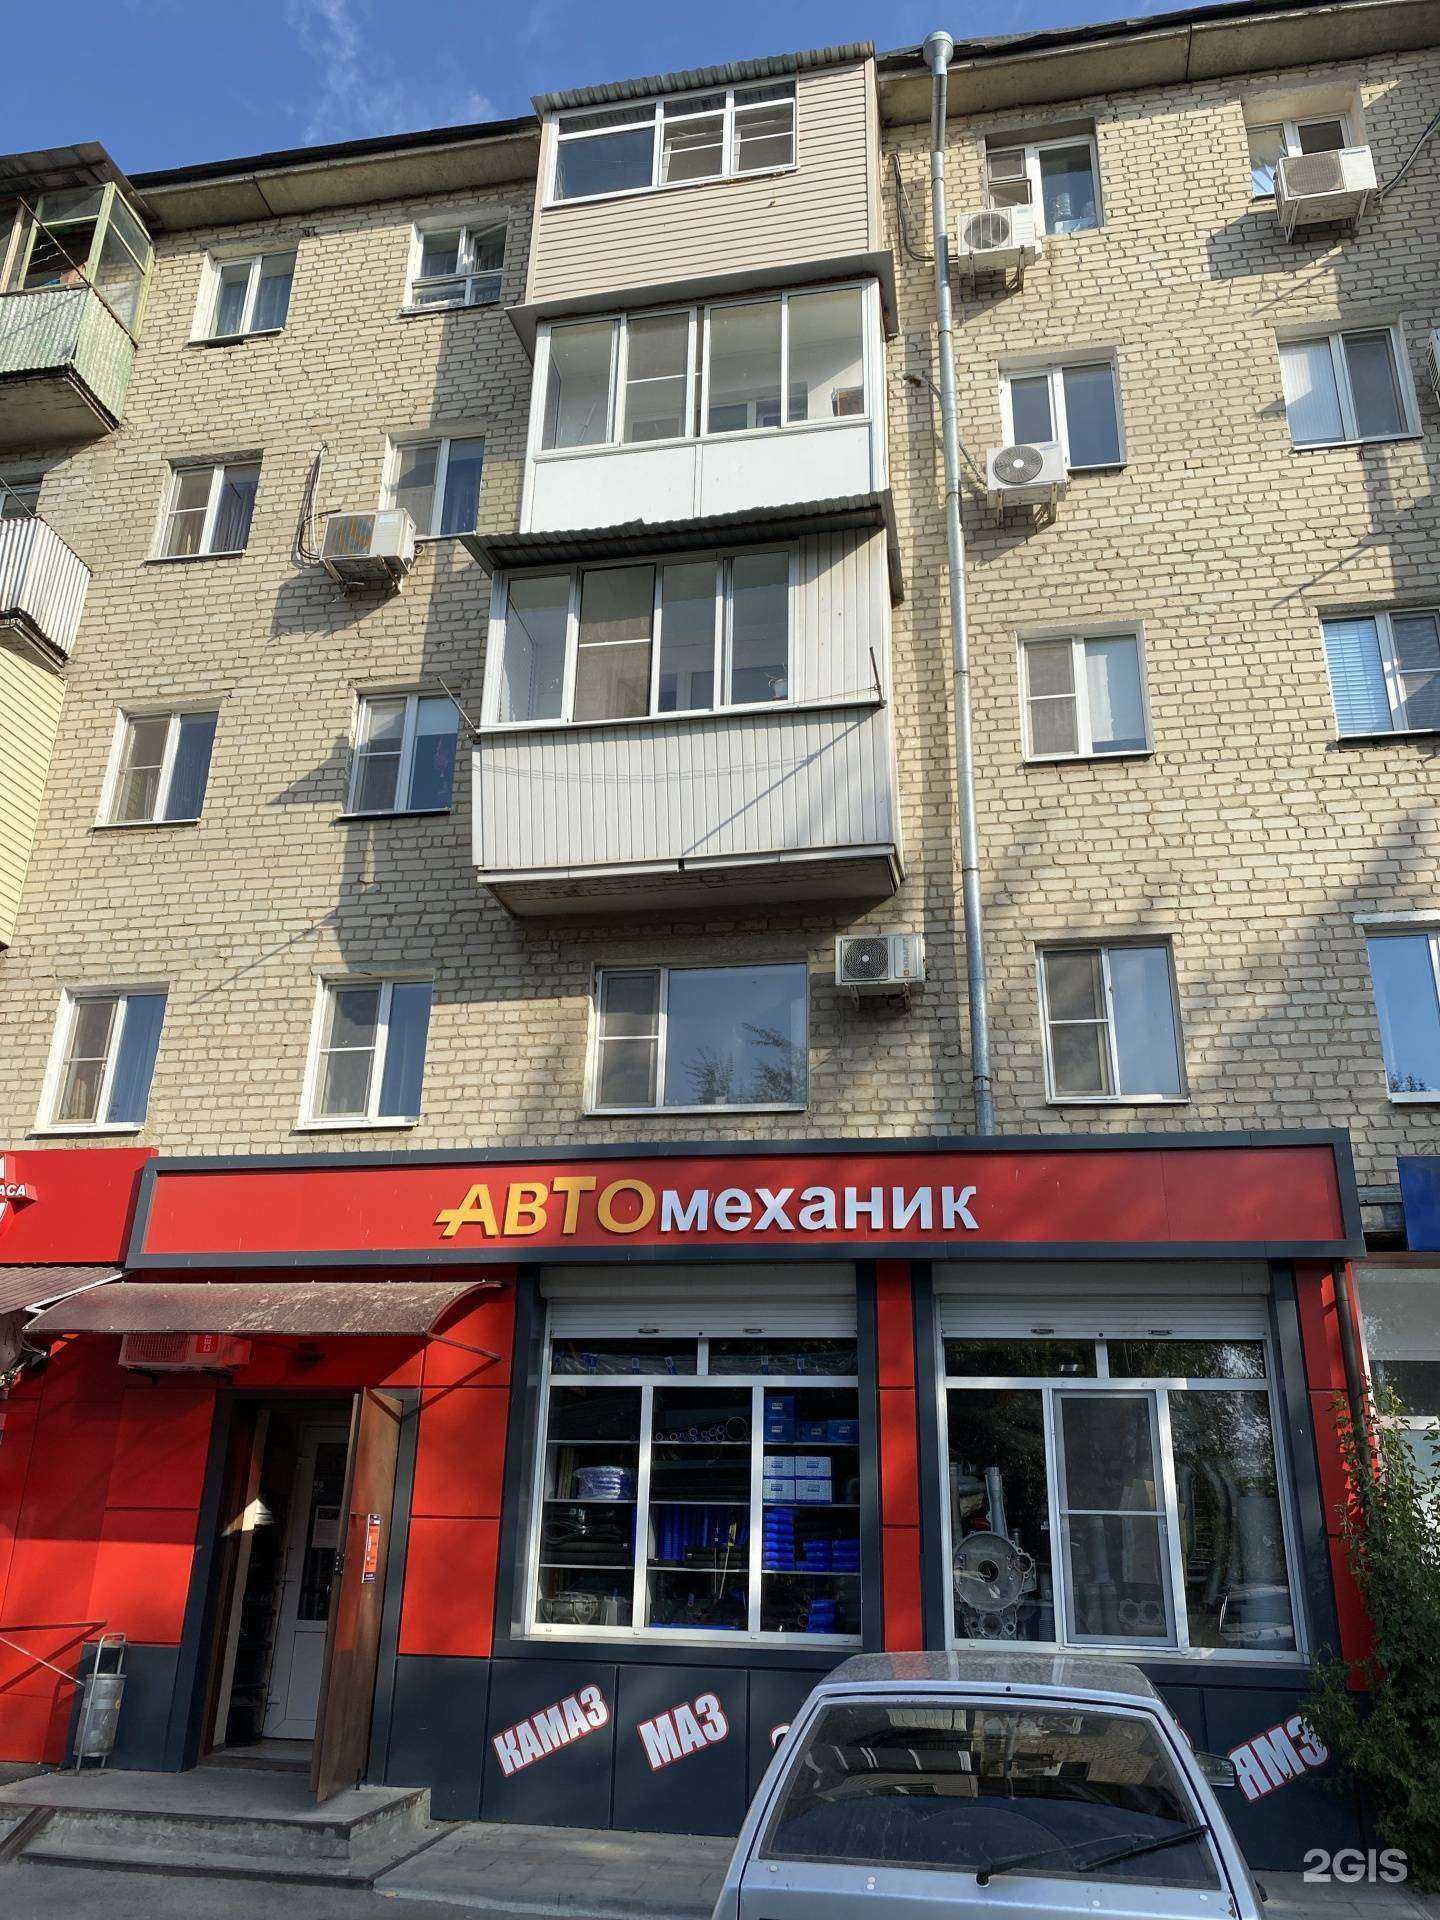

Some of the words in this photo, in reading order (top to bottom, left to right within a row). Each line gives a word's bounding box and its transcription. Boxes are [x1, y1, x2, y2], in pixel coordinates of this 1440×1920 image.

[434, 1176, 979, 1237] АВТОмеханик
[493, 1685, 609, 1776] КАМАЗ
[639, 1693, 728, 1770] МАЗ
[1229, 1715, 1328, 1800] ЯМЗ
